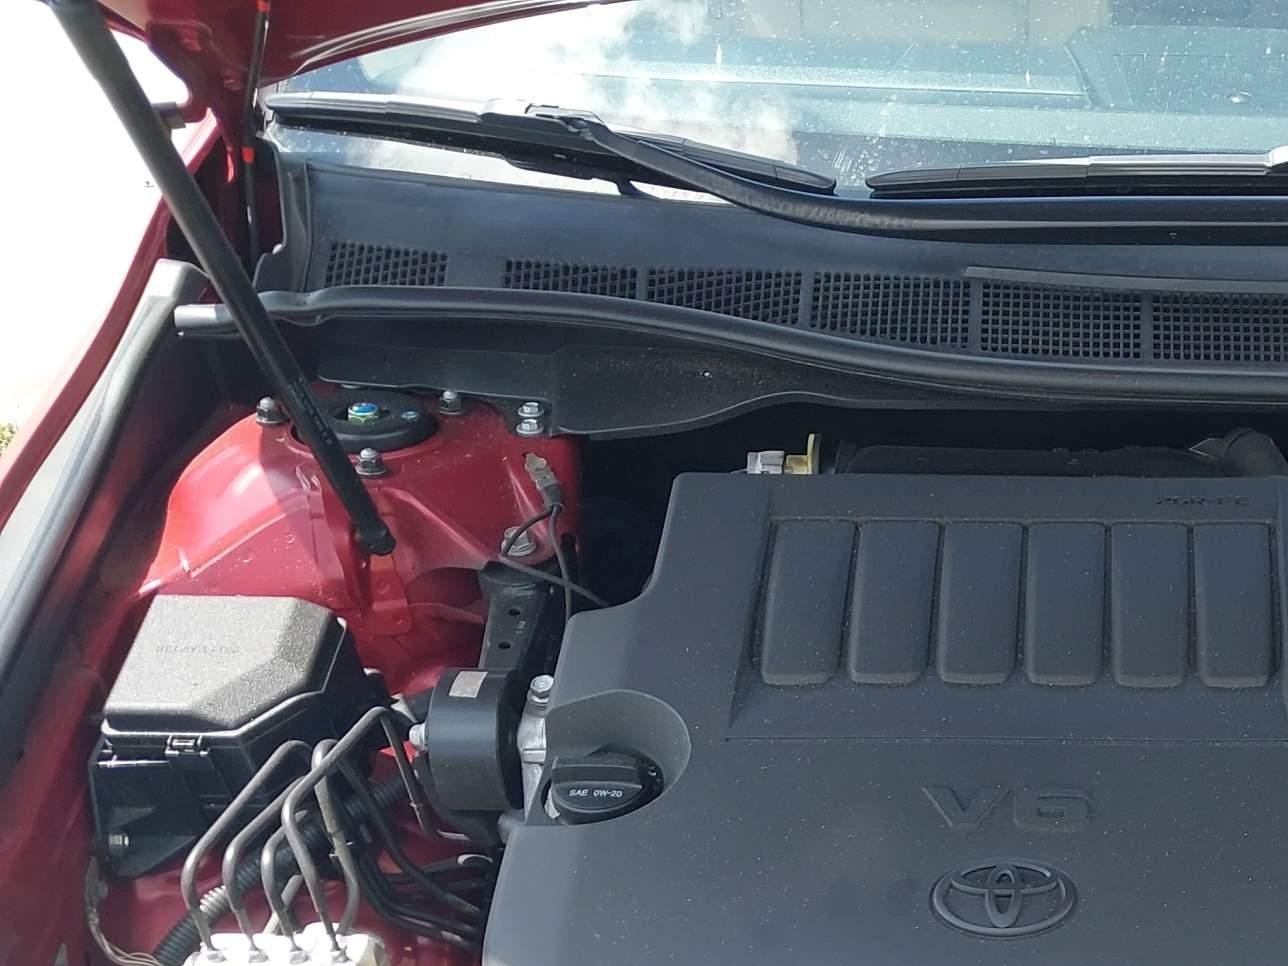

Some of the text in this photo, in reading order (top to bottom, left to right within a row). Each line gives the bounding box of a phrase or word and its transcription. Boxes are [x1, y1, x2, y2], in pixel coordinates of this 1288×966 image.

[568, 788, 623, 798] SAE 0W-20
[921, 784, 1094, 832] V6
